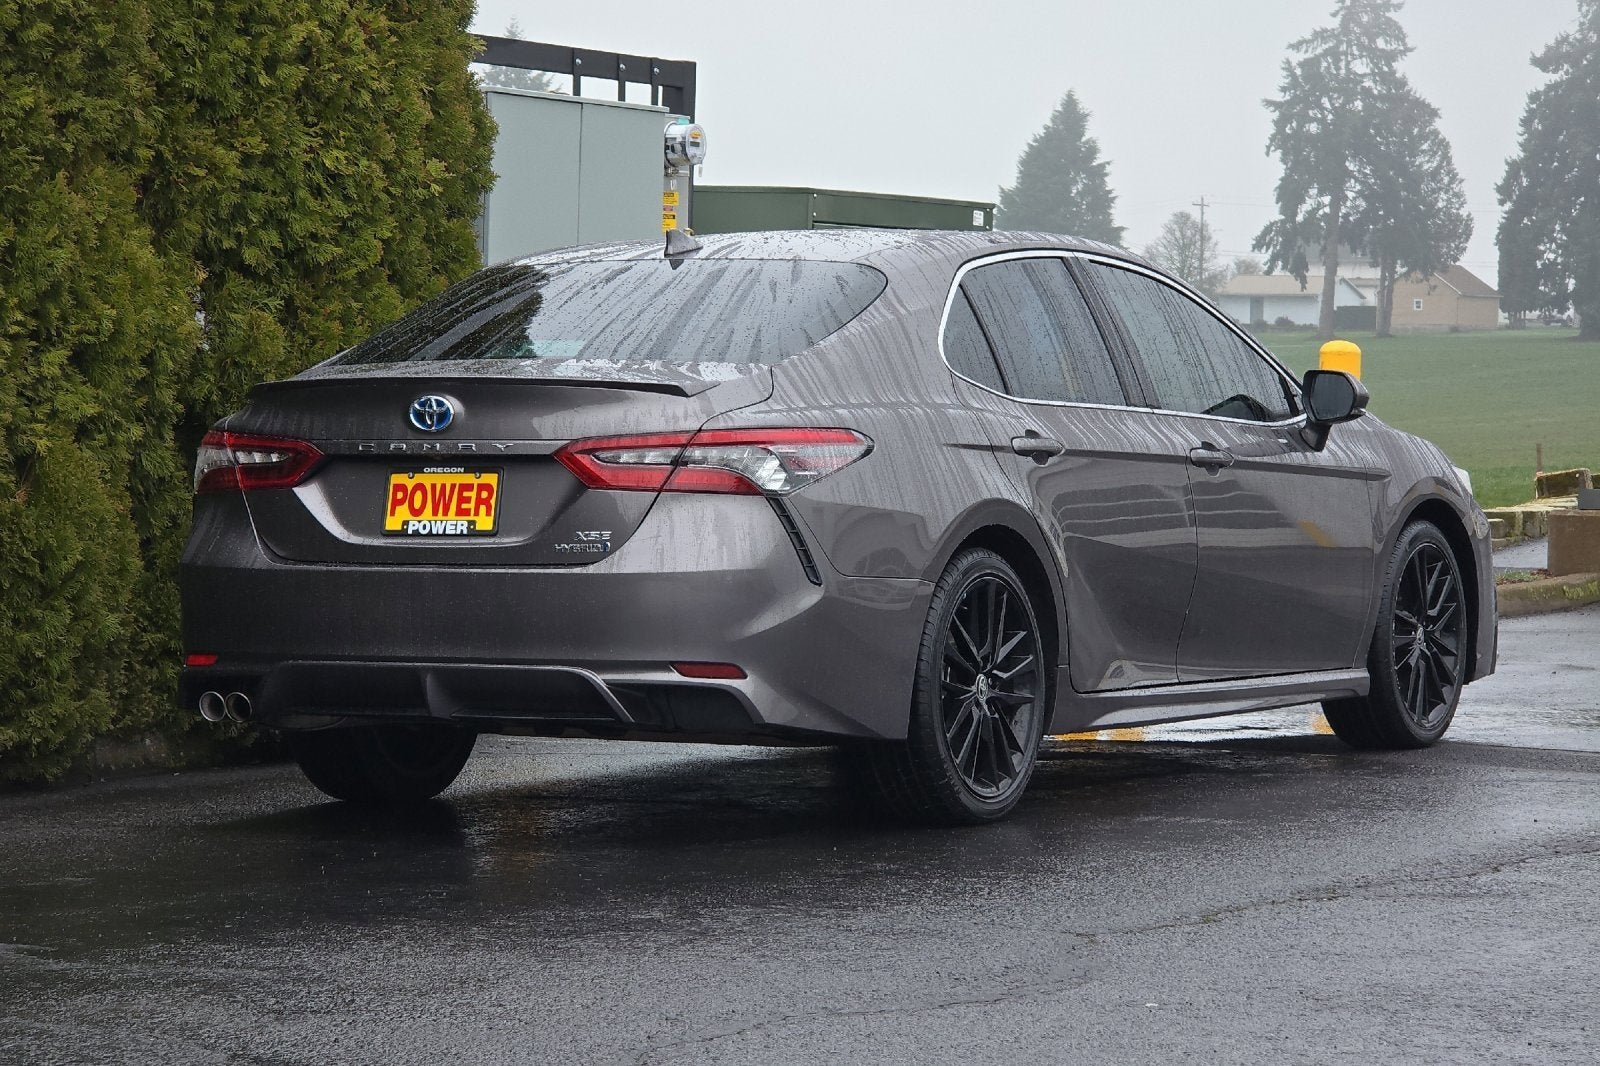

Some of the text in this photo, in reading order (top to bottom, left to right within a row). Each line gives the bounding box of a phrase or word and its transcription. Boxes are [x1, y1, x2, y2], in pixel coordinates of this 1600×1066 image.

[358, 443, 514, 452] CAMRY
[389, 482, 495, 518] POWER
[407, 520, 469, 535] POWER
[574, 531, 612, 541] XSE
[554, 543, 604, 552] HYBRID
